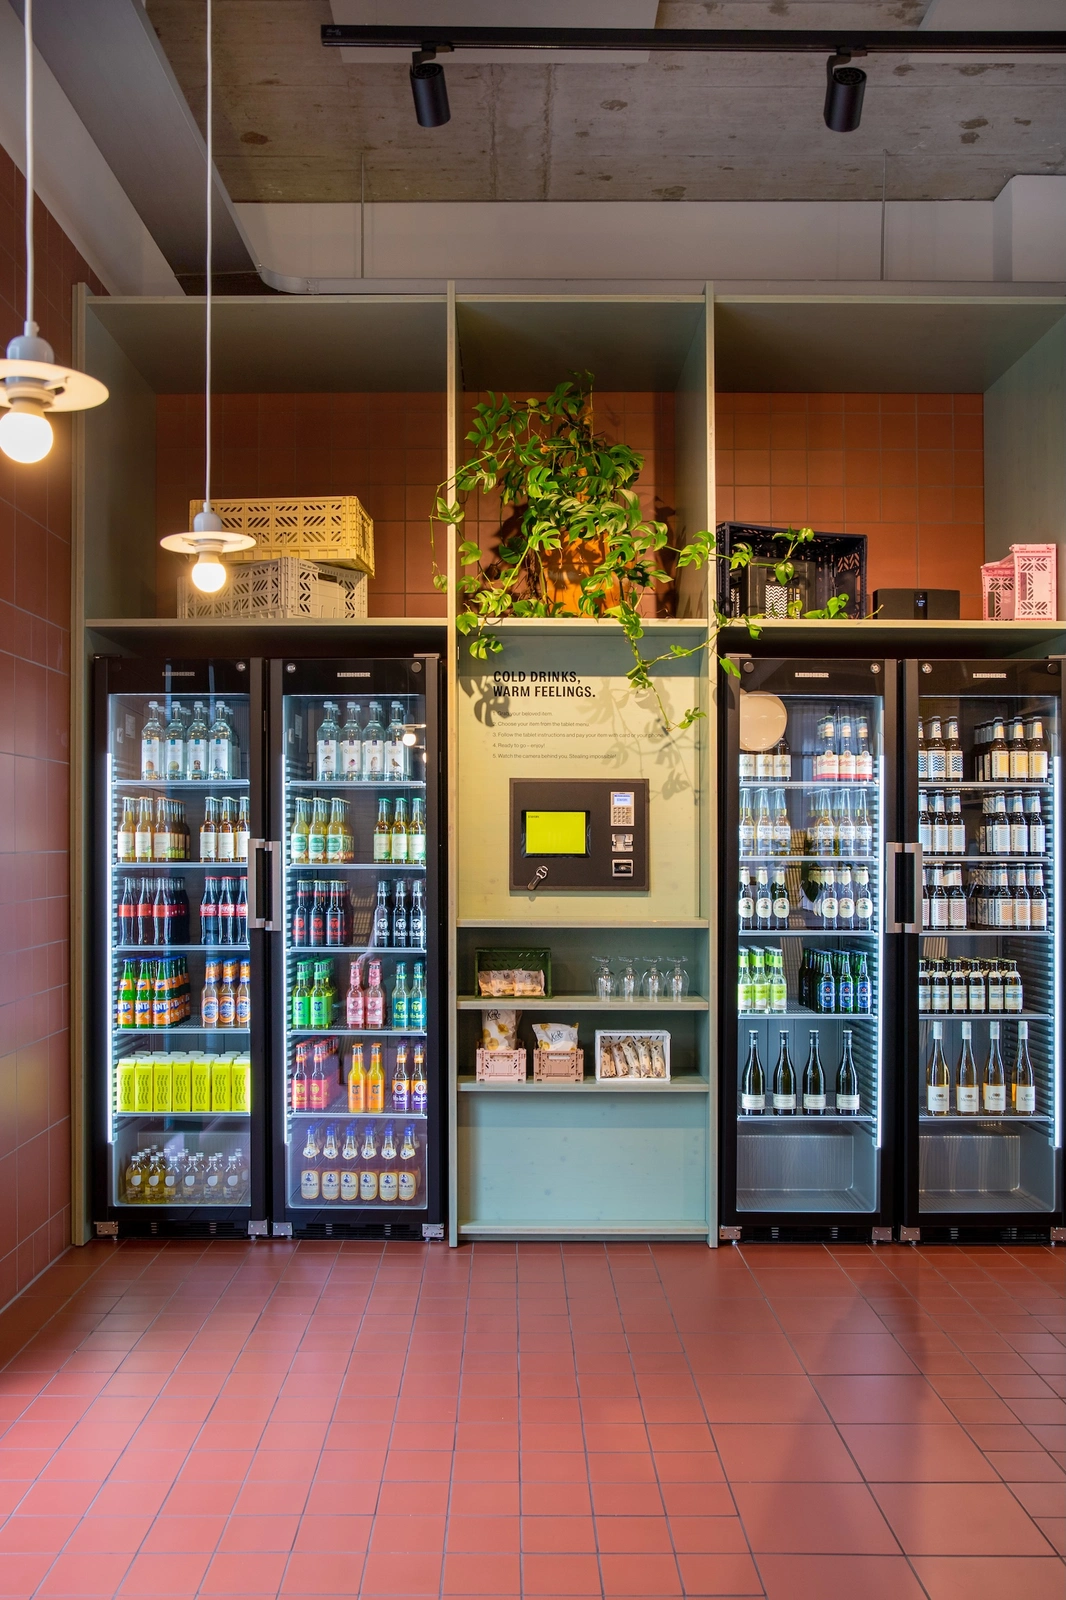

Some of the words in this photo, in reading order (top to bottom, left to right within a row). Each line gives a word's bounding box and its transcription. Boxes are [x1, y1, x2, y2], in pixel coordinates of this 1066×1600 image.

[493, 670, 526, 683] COLD
[530, 670, 581, 684] DRINKS,
[493, 686, 530, 697] WARM
[535, 686, 596, 697] FEELINGS.
